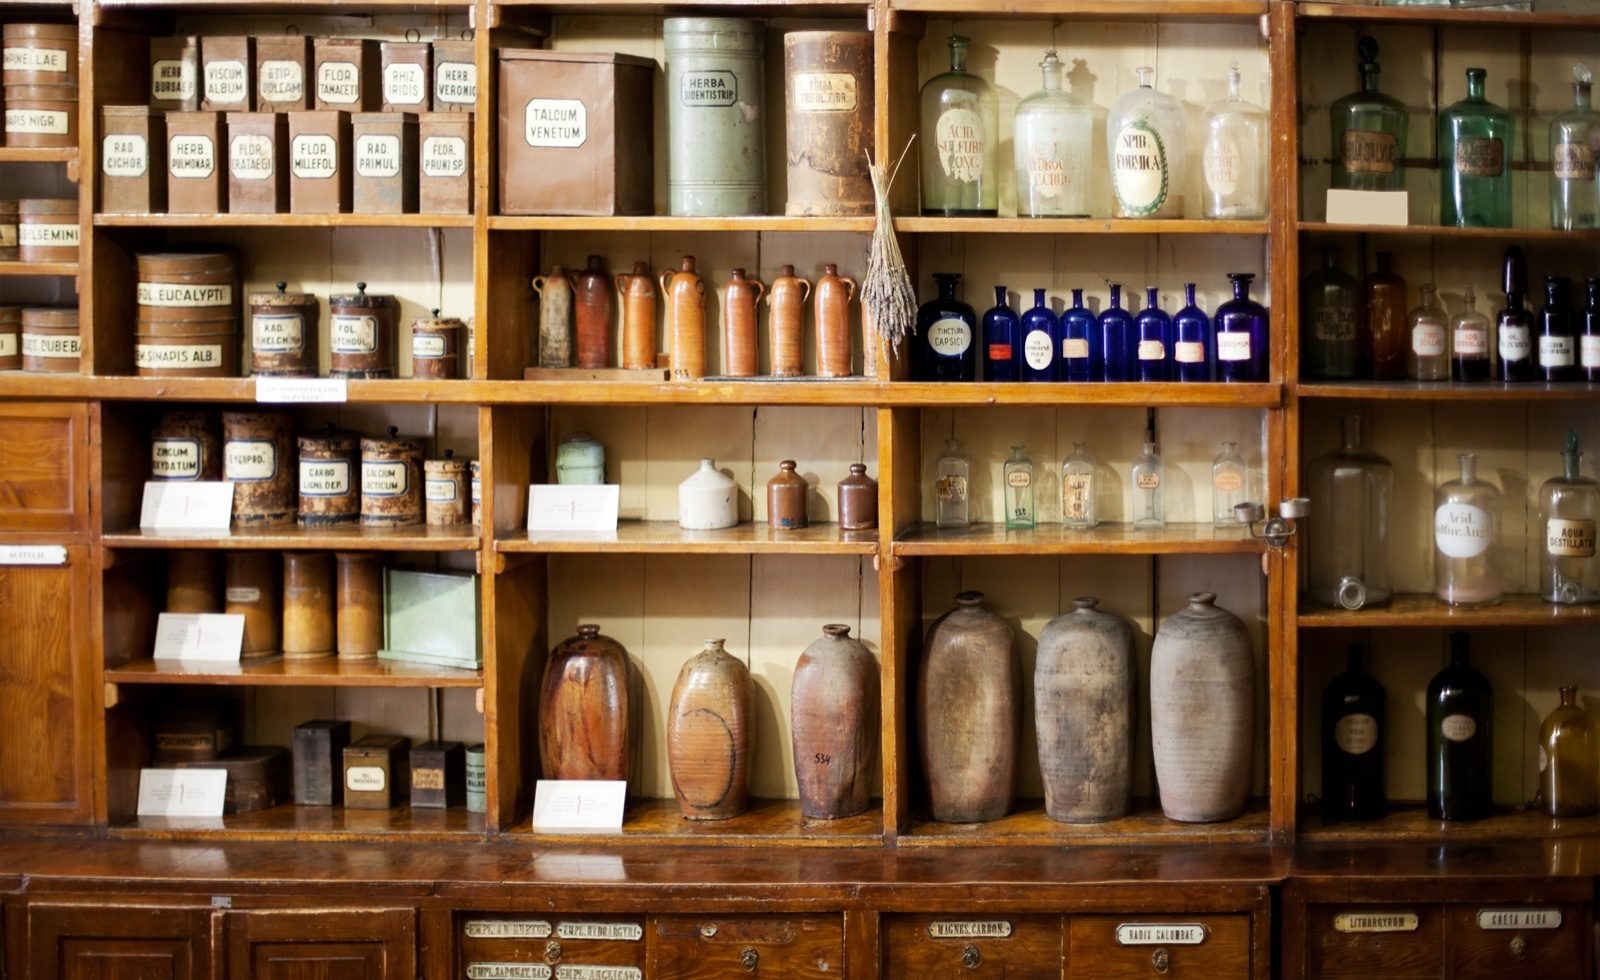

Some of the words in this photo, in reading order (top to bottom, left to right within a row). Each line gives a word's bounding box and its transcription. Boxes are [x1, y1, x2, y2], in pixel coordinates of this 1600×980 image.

[208, 67, 243, 80] VISCUM
[208, 82, 243, 94] ALBUM
[689, 78, 726, 89] HERBA
[388, 85, 419, 96] IRIDIS
[533, 109, 577, 122] TALCUM
[530, 127, 581, 139] VENETUM
[948, 125, 975, 139] ACID.
[301, 143, 330, 155] FLOR.
[359, 158, 397, 170] PRIMUL.
[159, 287, 223, 302] EUCALYPTI
[937, 327, 965, 335] TINCTURA
[934, 337, 964, 347] CAPSICI
[1561, 528, 1584, 537] AQUA
[815, 753, 831, 765] 534
[1492, 913, 1519, 926] CRETA
[1129, 929, 1152, 940] RADIX
